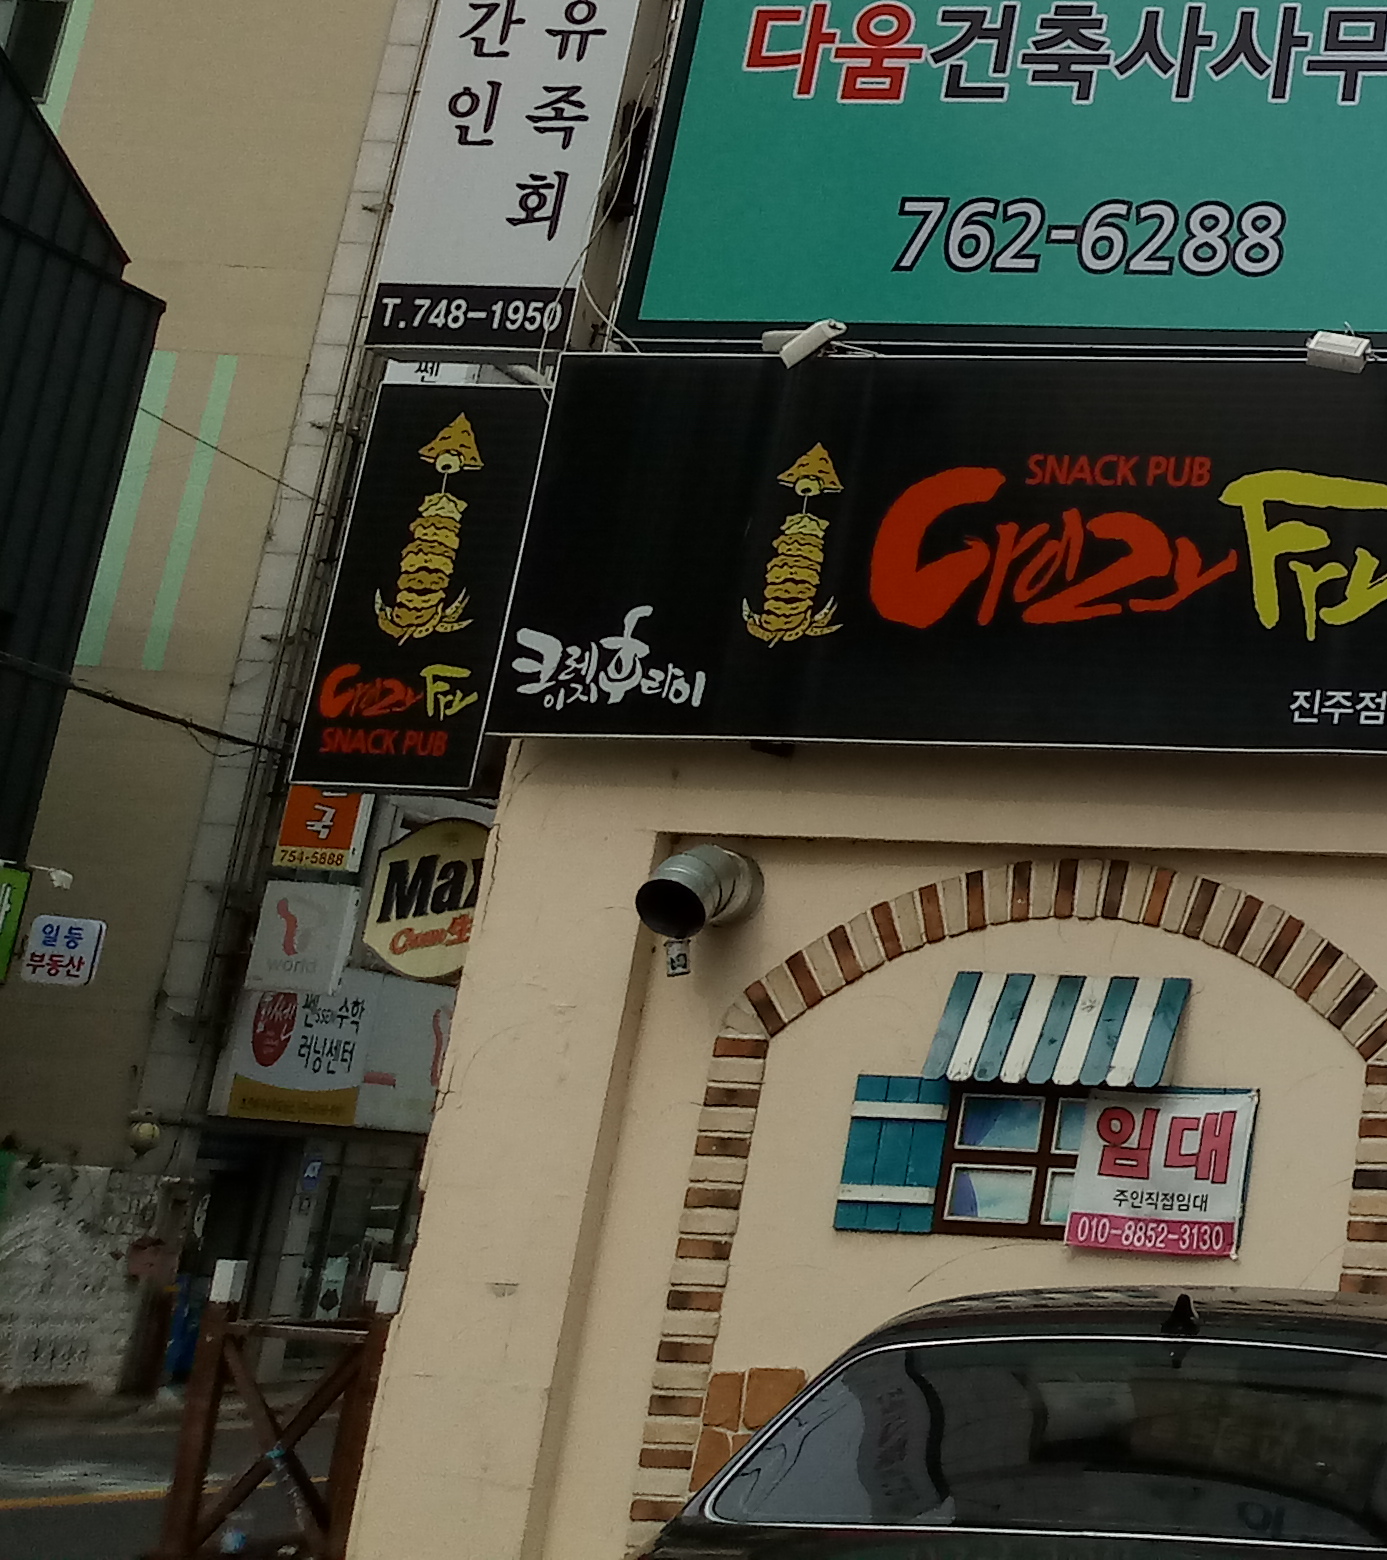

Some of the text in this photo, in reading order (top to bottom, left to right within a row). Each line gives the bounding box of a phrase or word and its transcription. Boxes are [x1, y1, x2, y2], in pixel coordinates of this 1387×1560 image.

[891, 196, 1287, 279] 762-6288
[380, 296, 565, 334] T.748-1950
[1024, 453, 1213, 489] SNACK PUB
[869, 465, 1239, 630] Crazy
[319, 726, 448, 757] SNACK PUB
[26, 951, 86, 979] 부동산
[1095, 1106, 1238, 1184] 임대
[1112, 1188, 1210, 1213] 주인직접임대
[1076, 1215, 1224, 1253] 010-8852-3130
